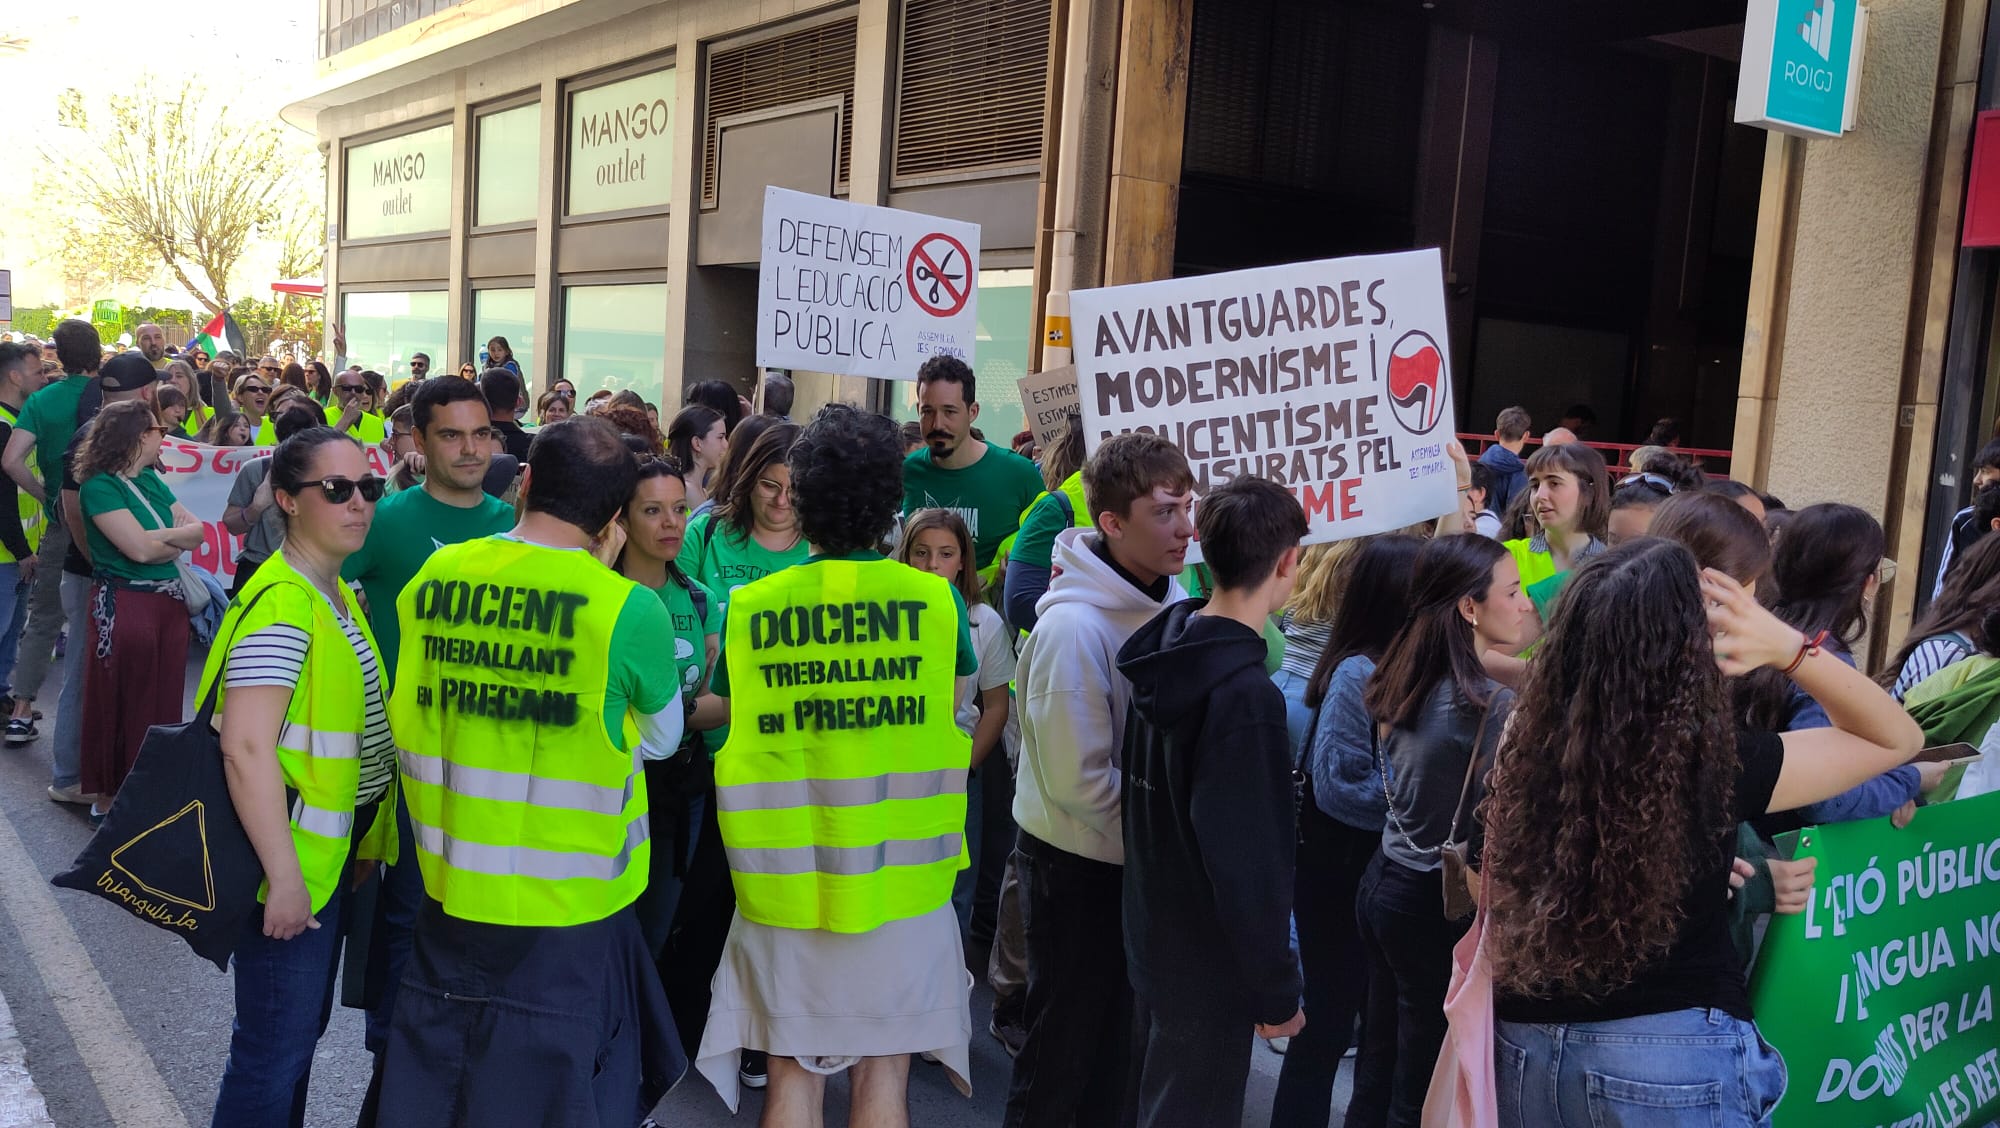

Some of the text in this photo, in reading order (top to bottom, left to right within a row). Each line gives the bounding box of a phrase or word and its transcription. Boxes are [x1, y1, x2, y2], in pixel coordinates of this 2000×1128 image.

[1785, 60, 1833, 93] ROIGJ
[581, 98, 668, 150] MANGO
[373, 151, 425, 188] MANGO
[596, 147, 647, 187] outlet
[382, 188, 413, 217] outlet
[778, 217, 903, 270] DEFENSEM
[776, 264, 904, 313] L'EDUCACIÓ
[774, 306, 896, 361] PÚBLICA
[1095, 339, 1358, 416] MODERNISME
[1356, 436, 1402, 475] PEL
[415, 579, 588, 639] DOCENT
[750, 600, 927, 650] DOCENT
[422, 634, 575, 676] TREBALLANT
[760, 656, 922, 688] TREBALLANT
[416, 678, 579, 727] EN PRECARI
[758, 695, 926, 734] EN PRECARI
[96, 868, 200, 931] triangulista
[1899, 1002, 1950, 1060] PER
[1957, 984, 1993, 1034] LA
